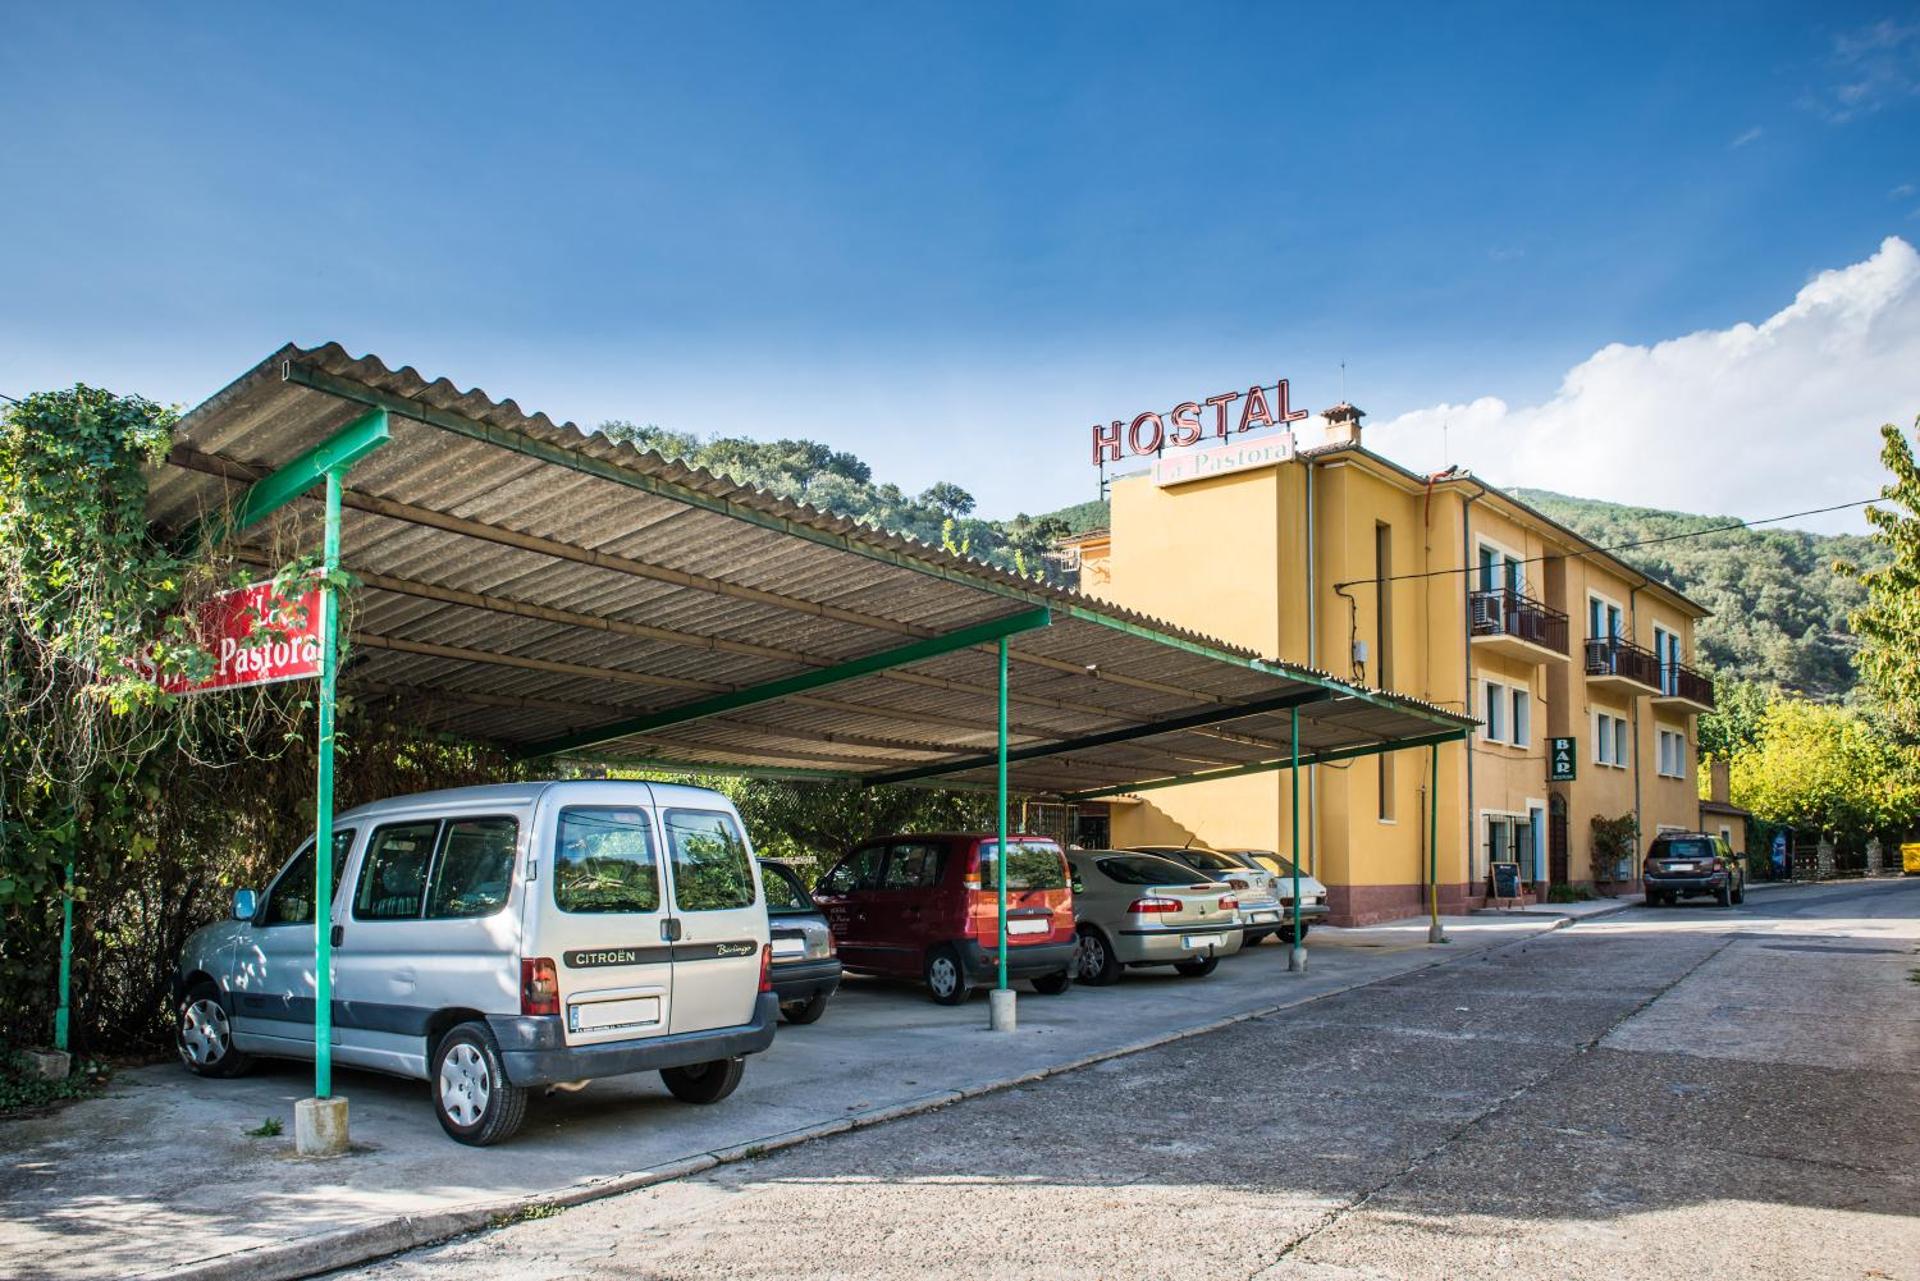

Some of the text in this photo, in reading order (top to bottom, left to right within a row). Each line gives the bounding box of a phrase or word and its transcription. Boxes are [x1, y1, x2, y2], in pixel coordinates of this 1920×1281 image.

[1093, 379, 1308, 465] HOSTAL
[1195, 444, 1287, 474] Pastora
[219, 634, 317, 676] Pastora
[1556, 739, 1570, 773] BAR
[576, 949, 636, 965] CITROËN
